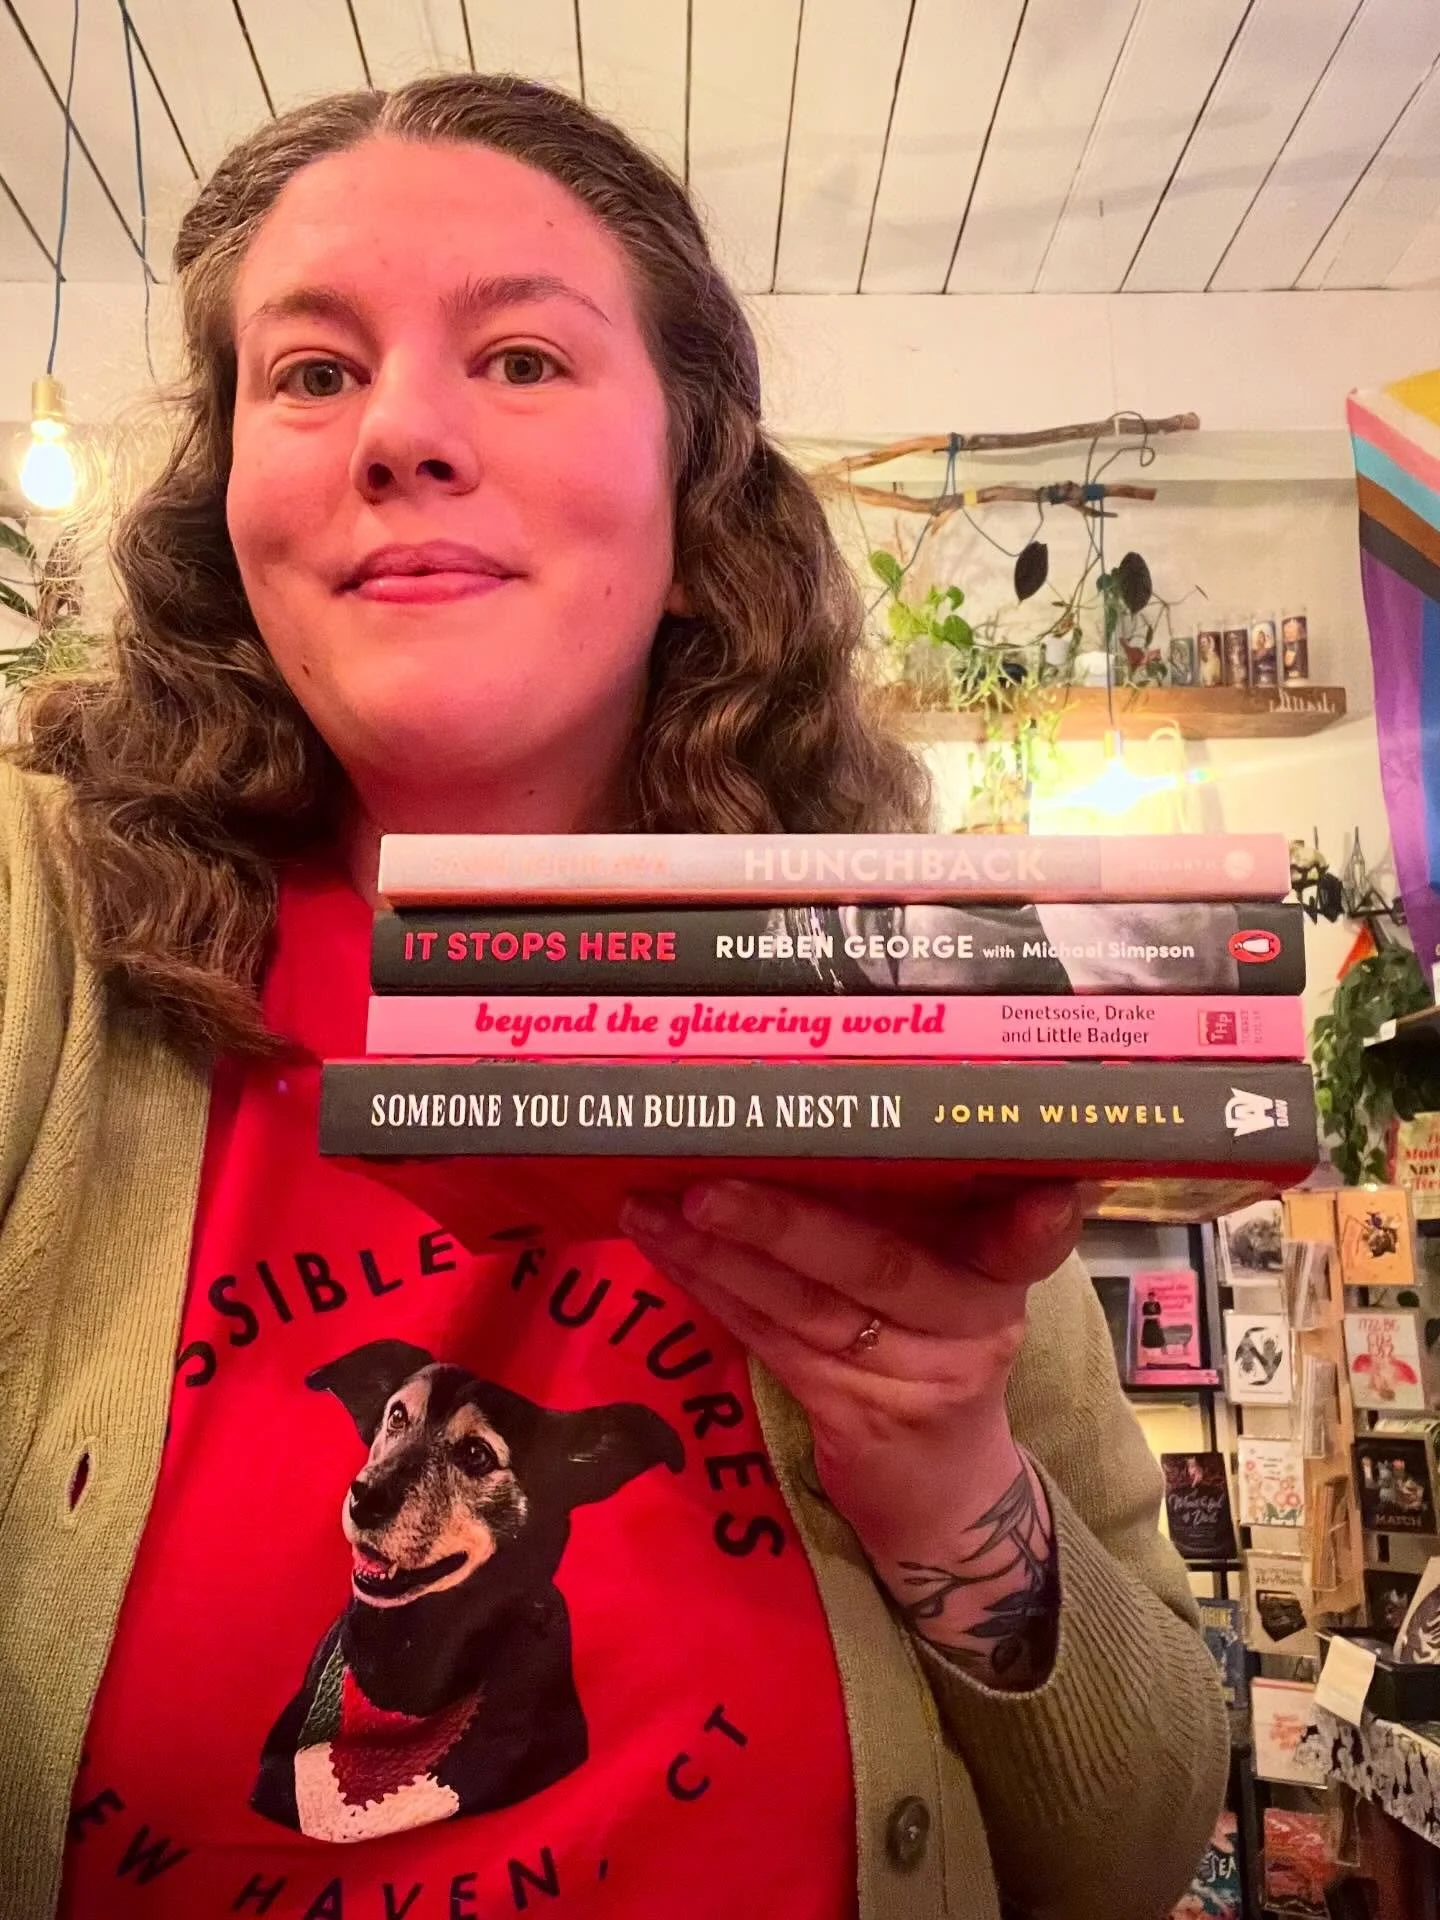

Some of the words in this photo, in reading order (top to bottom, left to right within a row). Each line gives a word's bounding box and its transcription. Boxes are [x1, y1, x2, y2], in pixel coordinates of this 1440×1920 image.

[745, 849, 1046, 881] HUNCHBACK
[405, 931, 438, 961] IT
[448, 931, 567, 961] STOPS
[579, 931, 676, 961] HERE
[716, 935, 833, 959] RUEBEN
[844, 935, 973, 959] GEORGE
[983, 944, 1015, 959] with
[1022, 942, 1103, 959] Michael
[1108, 942, 1195, 963] Simpson
[475, 1002, 598, 1047] beyond
[606, 1002, 659, 1033] the
[668, 1003, 831, 1048] glittering
[842, 1003, 945, 1034] world
[1001, 1005, 1100, 1022] Denetsosie,
[1105, 1005, 1155, 1021] Drake
[1001, 1027, 1031, 1044] and
[1037, 1027, 1081, 1044] Little
[1088, 1027, 1149, 1048] Badger
[371, 1094, 501, 1127] SOMEONE
[513, 1094, 569, 1127] YOU
[579, 1094, 633, 1127] CAN
[643, 1095, 736, 1127] BUILD
[746, 1095, 764, 1127] A
[776, 1095, 859, 1127] NEST
[870, 1095, 901, 1127] IN
[934, 1104, 1019, 1124] JOHN
[1040, 1104, 1185, 1124] WISWELL
[511, 1247, 785, 1557] FUTURES
[68, 1765, 193, 1885] EW
[666, 1703, 749, 1802] CT
